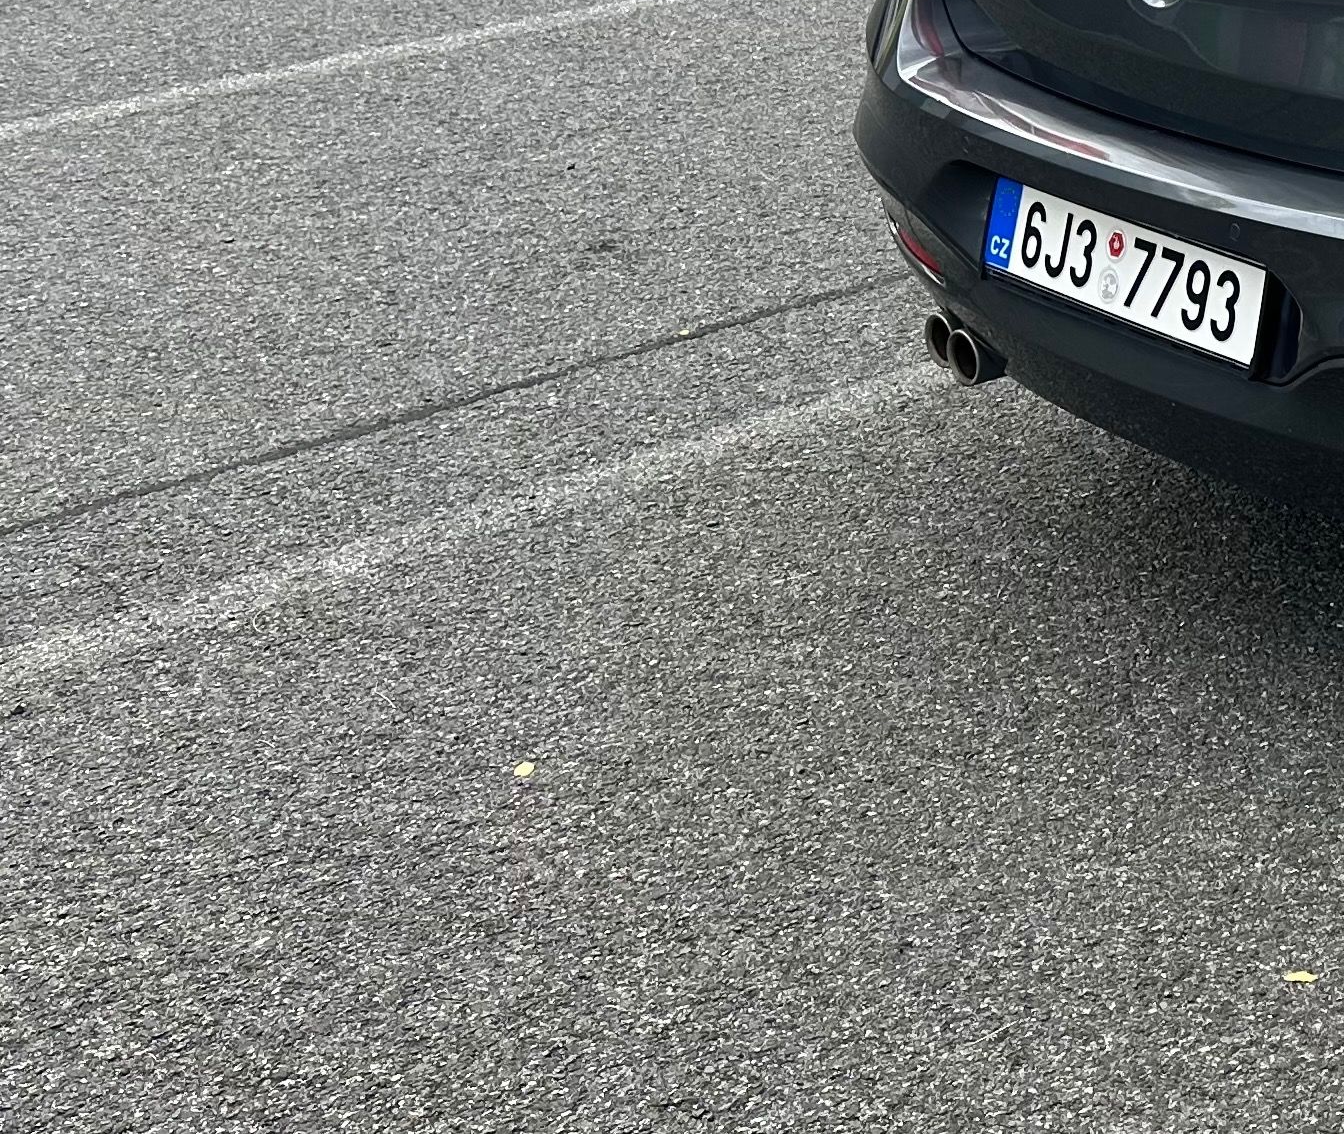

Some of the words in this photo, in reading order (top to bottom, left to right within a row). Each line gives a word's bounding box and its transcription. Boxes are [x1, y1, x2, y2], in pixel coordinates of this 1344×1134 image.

[990, 235, 1010, 259] CZ
[1021, 201, 1098, 288] 6J3
[1123, 236, 1241, 342] 7793
